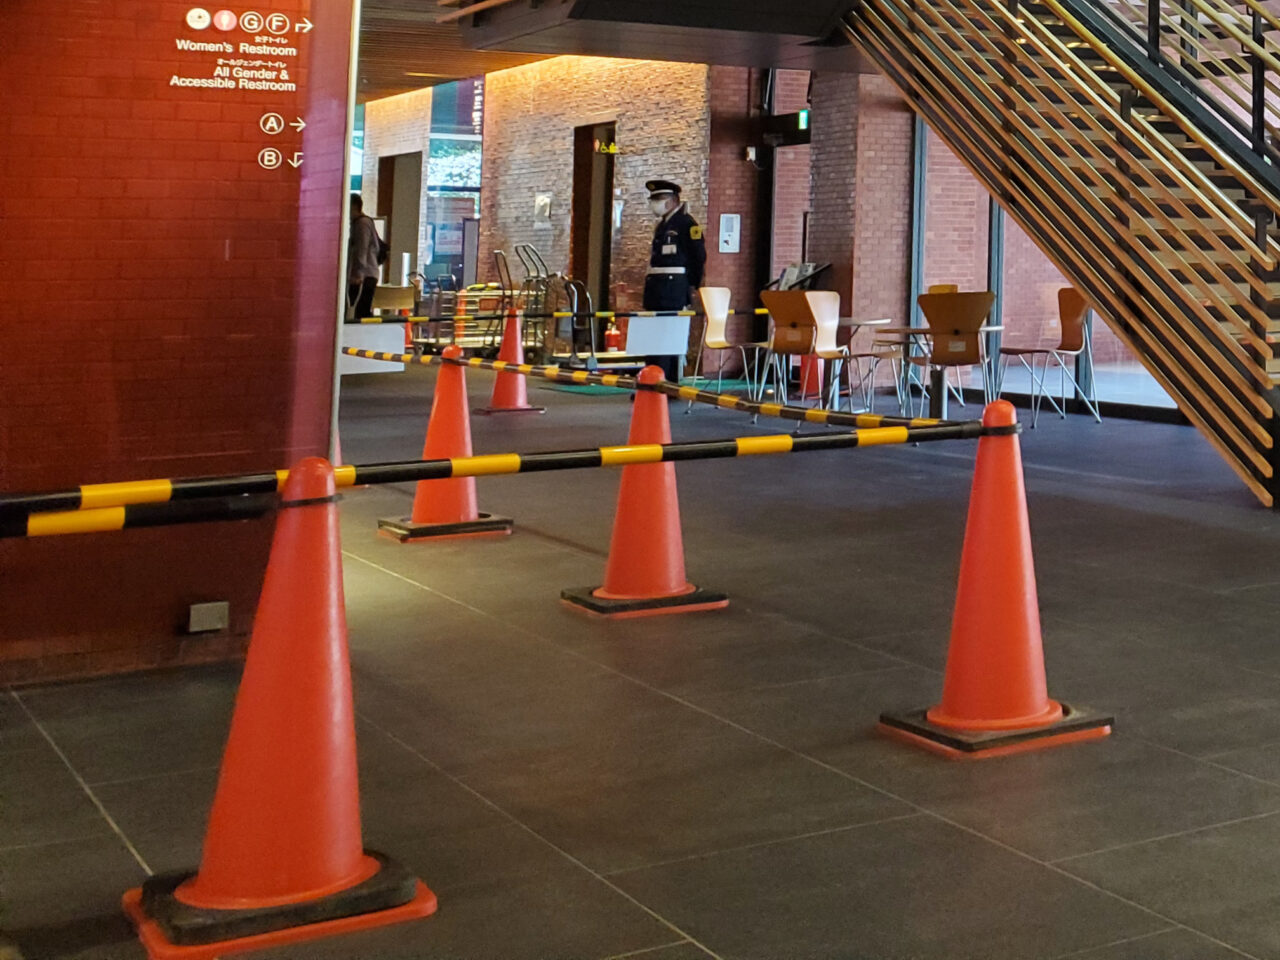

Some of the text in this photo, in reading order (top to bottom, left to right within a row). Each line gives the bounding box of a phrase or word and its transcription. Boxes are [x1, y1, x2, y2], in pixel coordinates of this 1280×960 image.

[176, 39, 297, 56] Women's Restroom
[213, 66, 289, 80] All Gender &
[170, 75, 296, 92] Accessible Restroom
